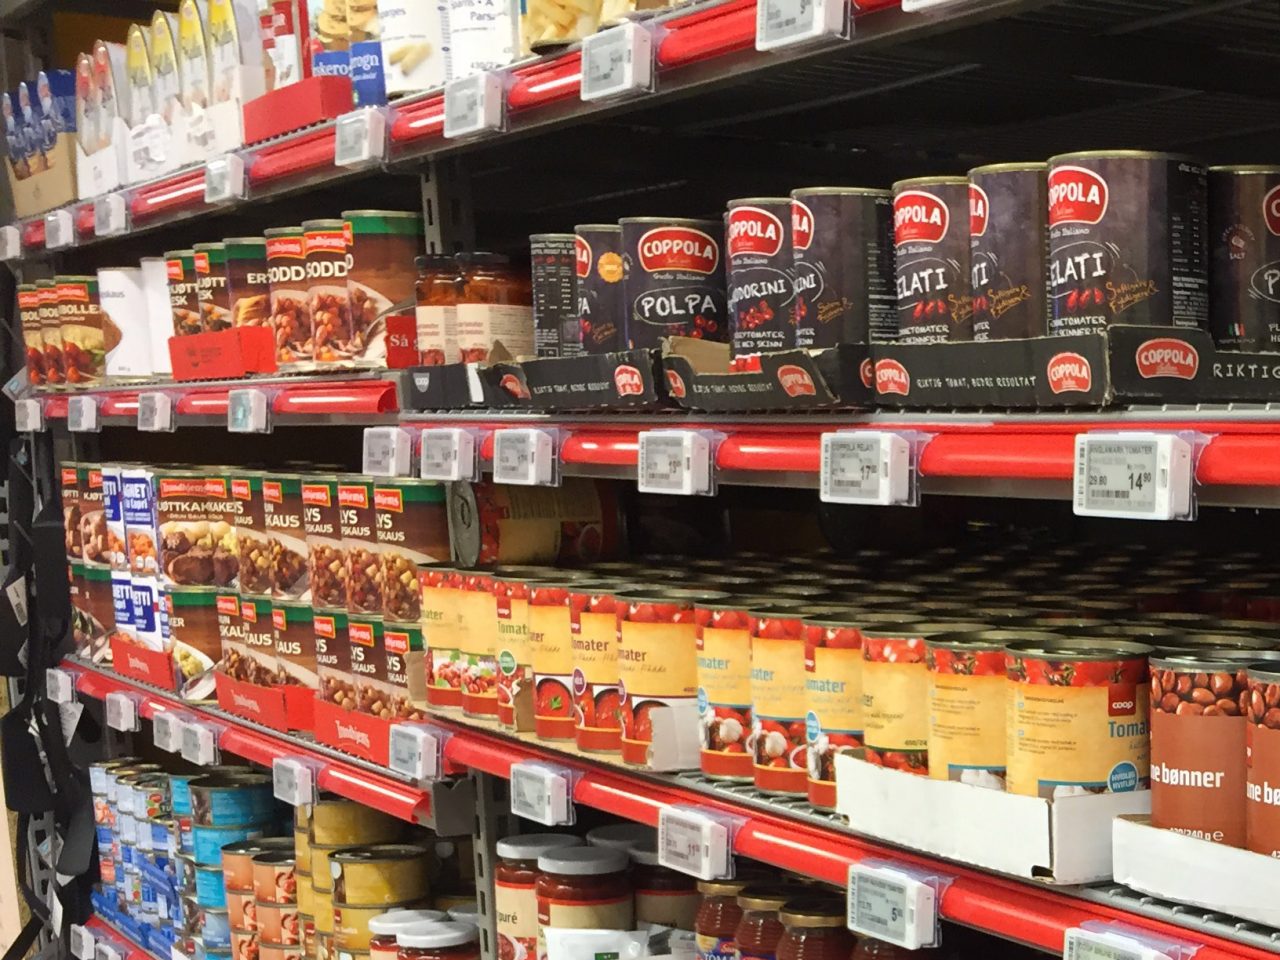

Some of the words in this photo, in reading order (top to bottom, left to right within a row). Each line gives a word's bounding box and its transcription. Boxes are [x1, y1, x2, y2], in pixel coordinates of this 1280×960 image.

[643, 242, 713, 259] COPPOLA
[641, 295, 717, 317] POLPA
[1141, 348, 1194, 367] COPPOLA
[877, 368, 907, 383] COPPOLA
[1051, 364, 1088, 381] COPPOLA
[1162, 762, 1225, 789] bønner
